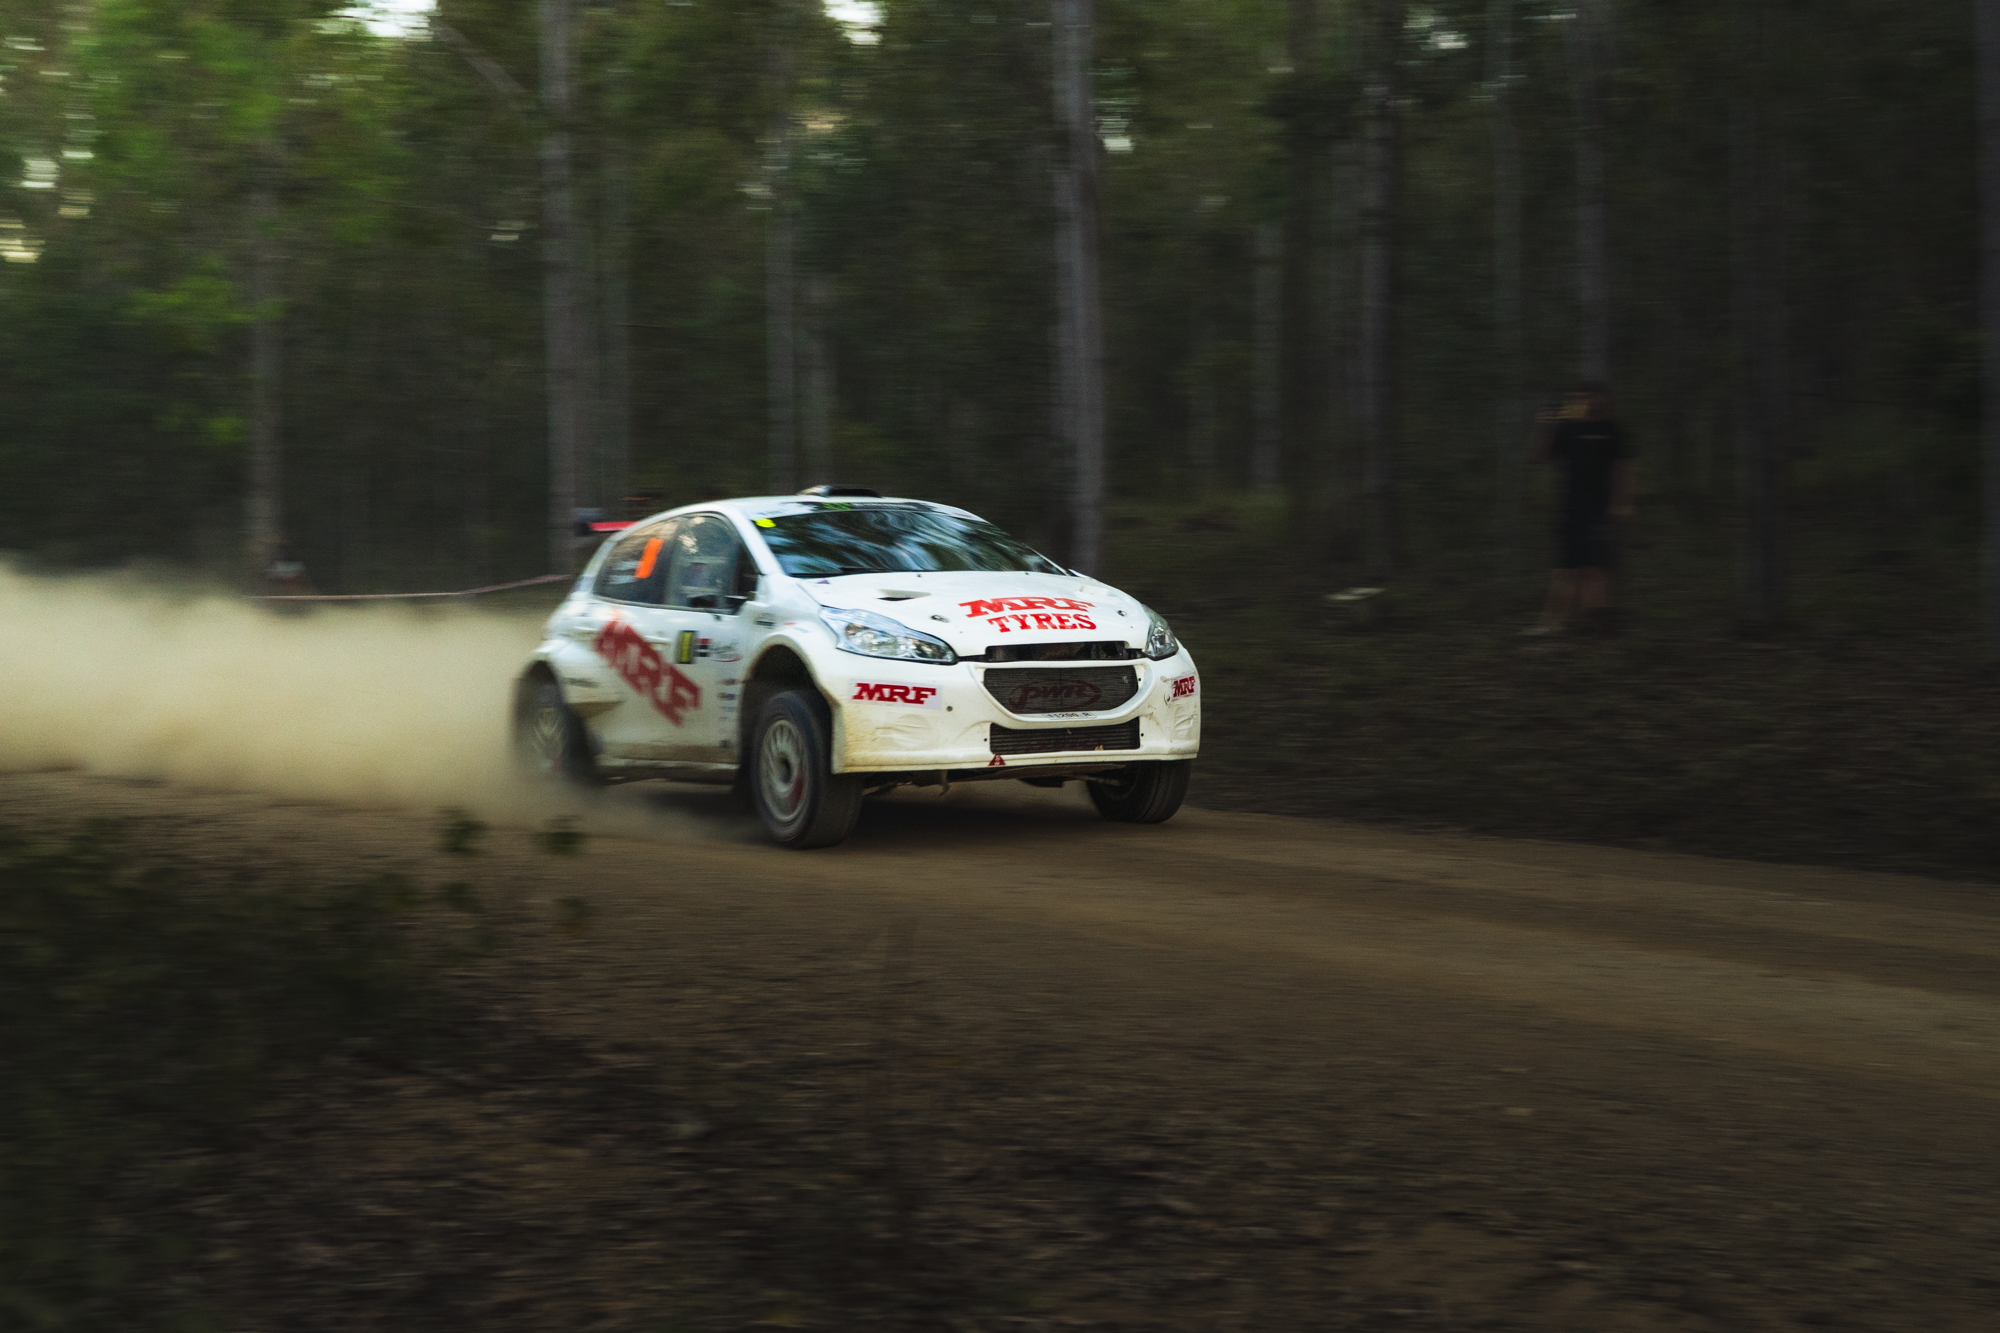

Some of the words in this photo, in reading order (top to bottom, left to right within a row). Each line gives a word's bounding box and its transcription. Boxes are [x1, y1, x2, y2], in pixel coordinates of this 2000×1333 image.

[957, 596, 1097, 618] MRF
[986, 613, 1097, 633] TYRES
[593, 618, 703, 728] MRF
[852, 682, 937, 705] MRF
[1172, 675, 1196, 698] MRF
